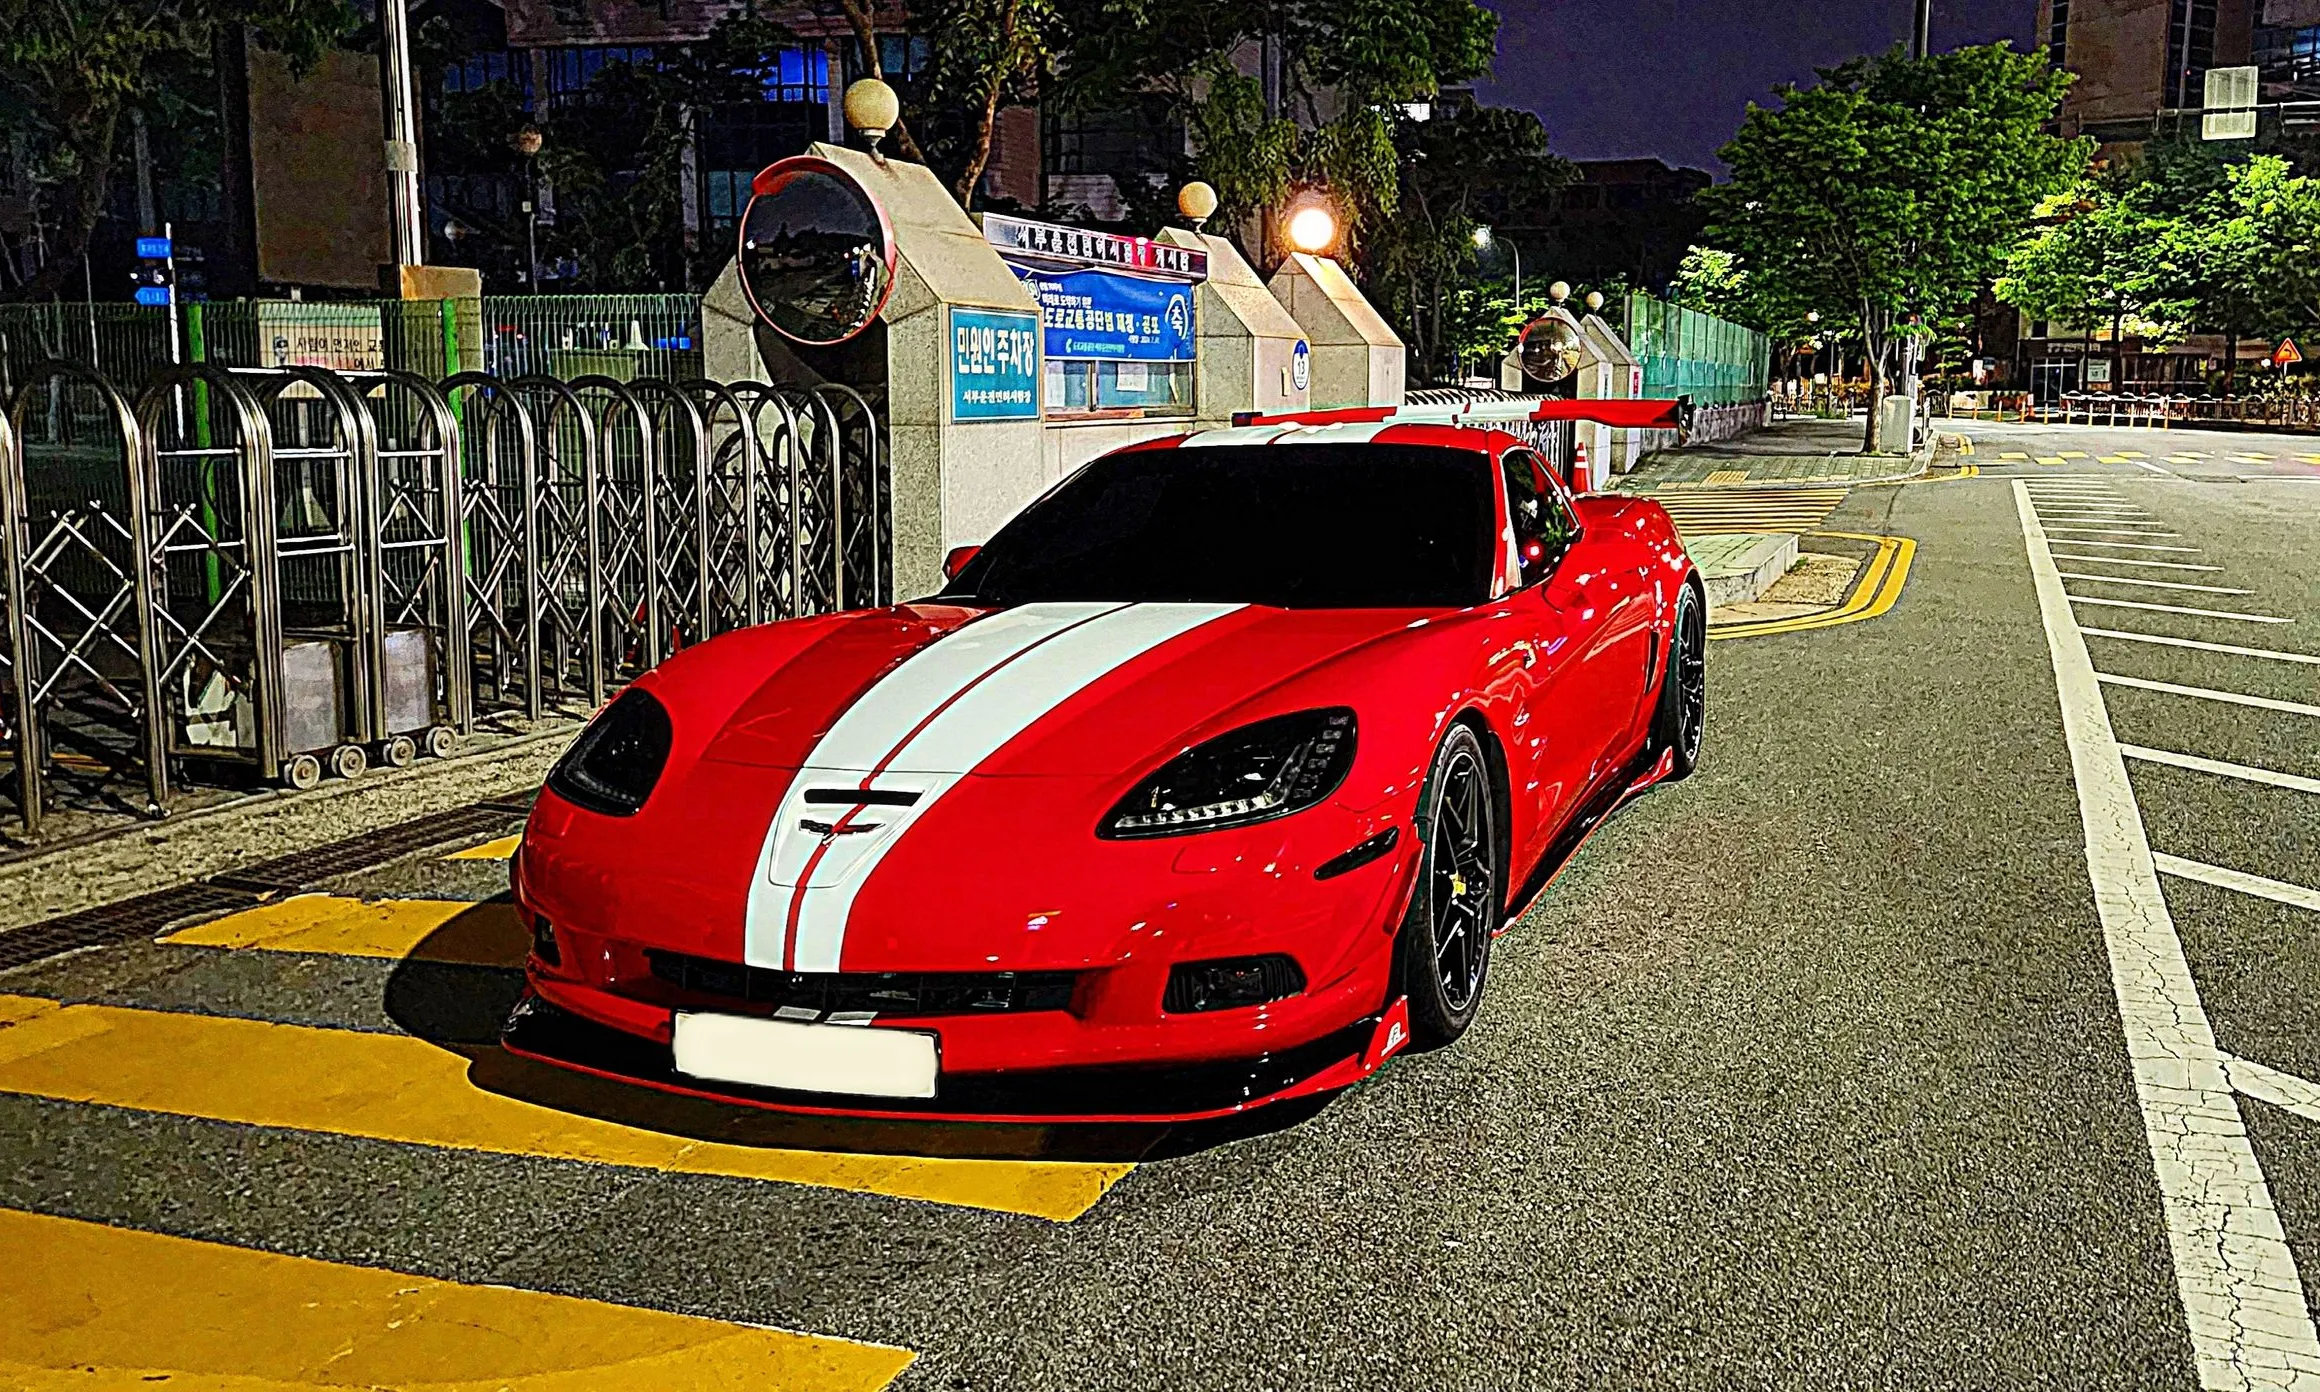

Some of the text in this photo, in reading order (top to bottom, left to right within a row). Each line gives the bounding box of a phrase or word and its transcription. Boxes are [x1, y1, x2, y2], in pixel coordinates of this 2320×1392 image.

[1016, 225, 1189, 272] 서부운전면허시험장 게시판
[1044, 307, 1115, 332] 도로교통공단법
[957, 326, 1035, 378] 민원인 주차장
[963, 389, 1032, 404] 서부운전면허시험장
